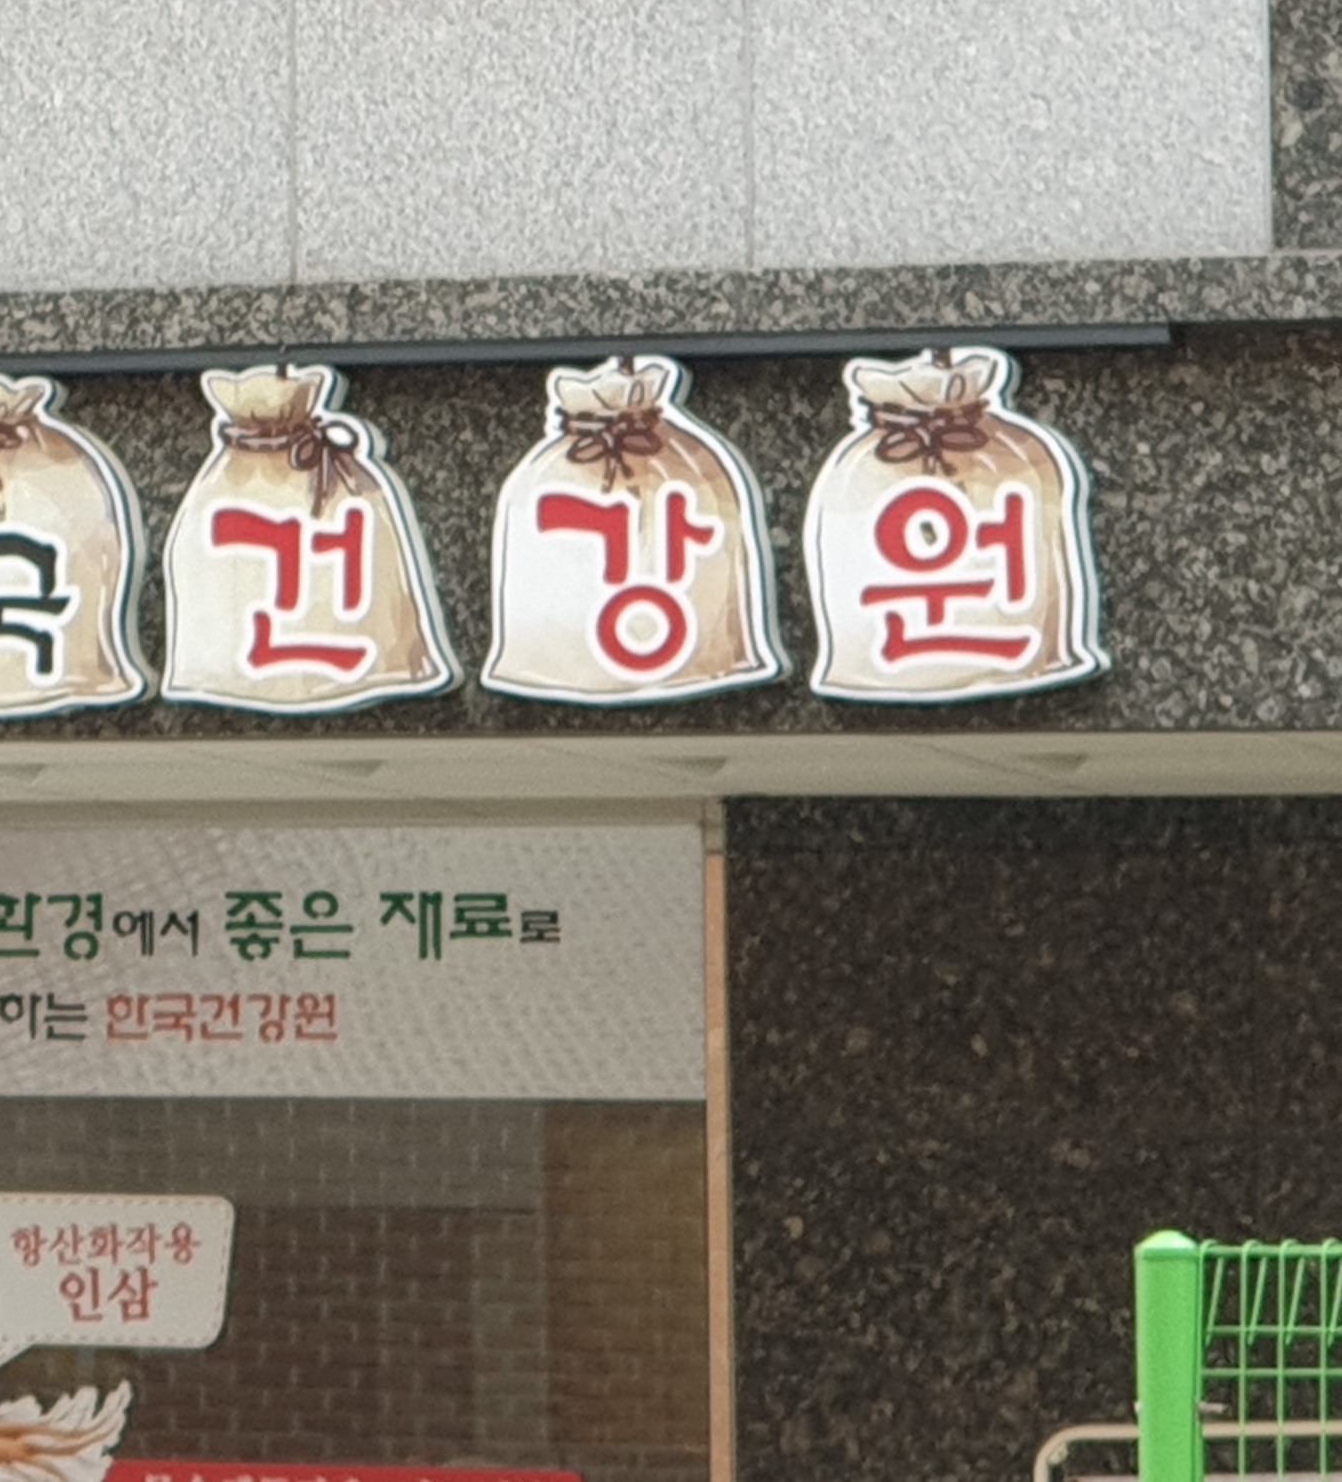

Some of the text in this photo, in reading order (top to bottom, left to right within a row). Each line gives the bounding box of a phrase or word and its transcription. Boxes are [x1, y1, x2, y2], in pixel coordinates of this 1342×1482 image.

[224, 891, 354, 961] 좋은
[379, 891, 561, 960] 재료로
[105, 992, 338, 1044] 한국건강원
[10, 1222, 202, 1268] 항산화작용
[58, 1266, 159, 1323] 인삼
